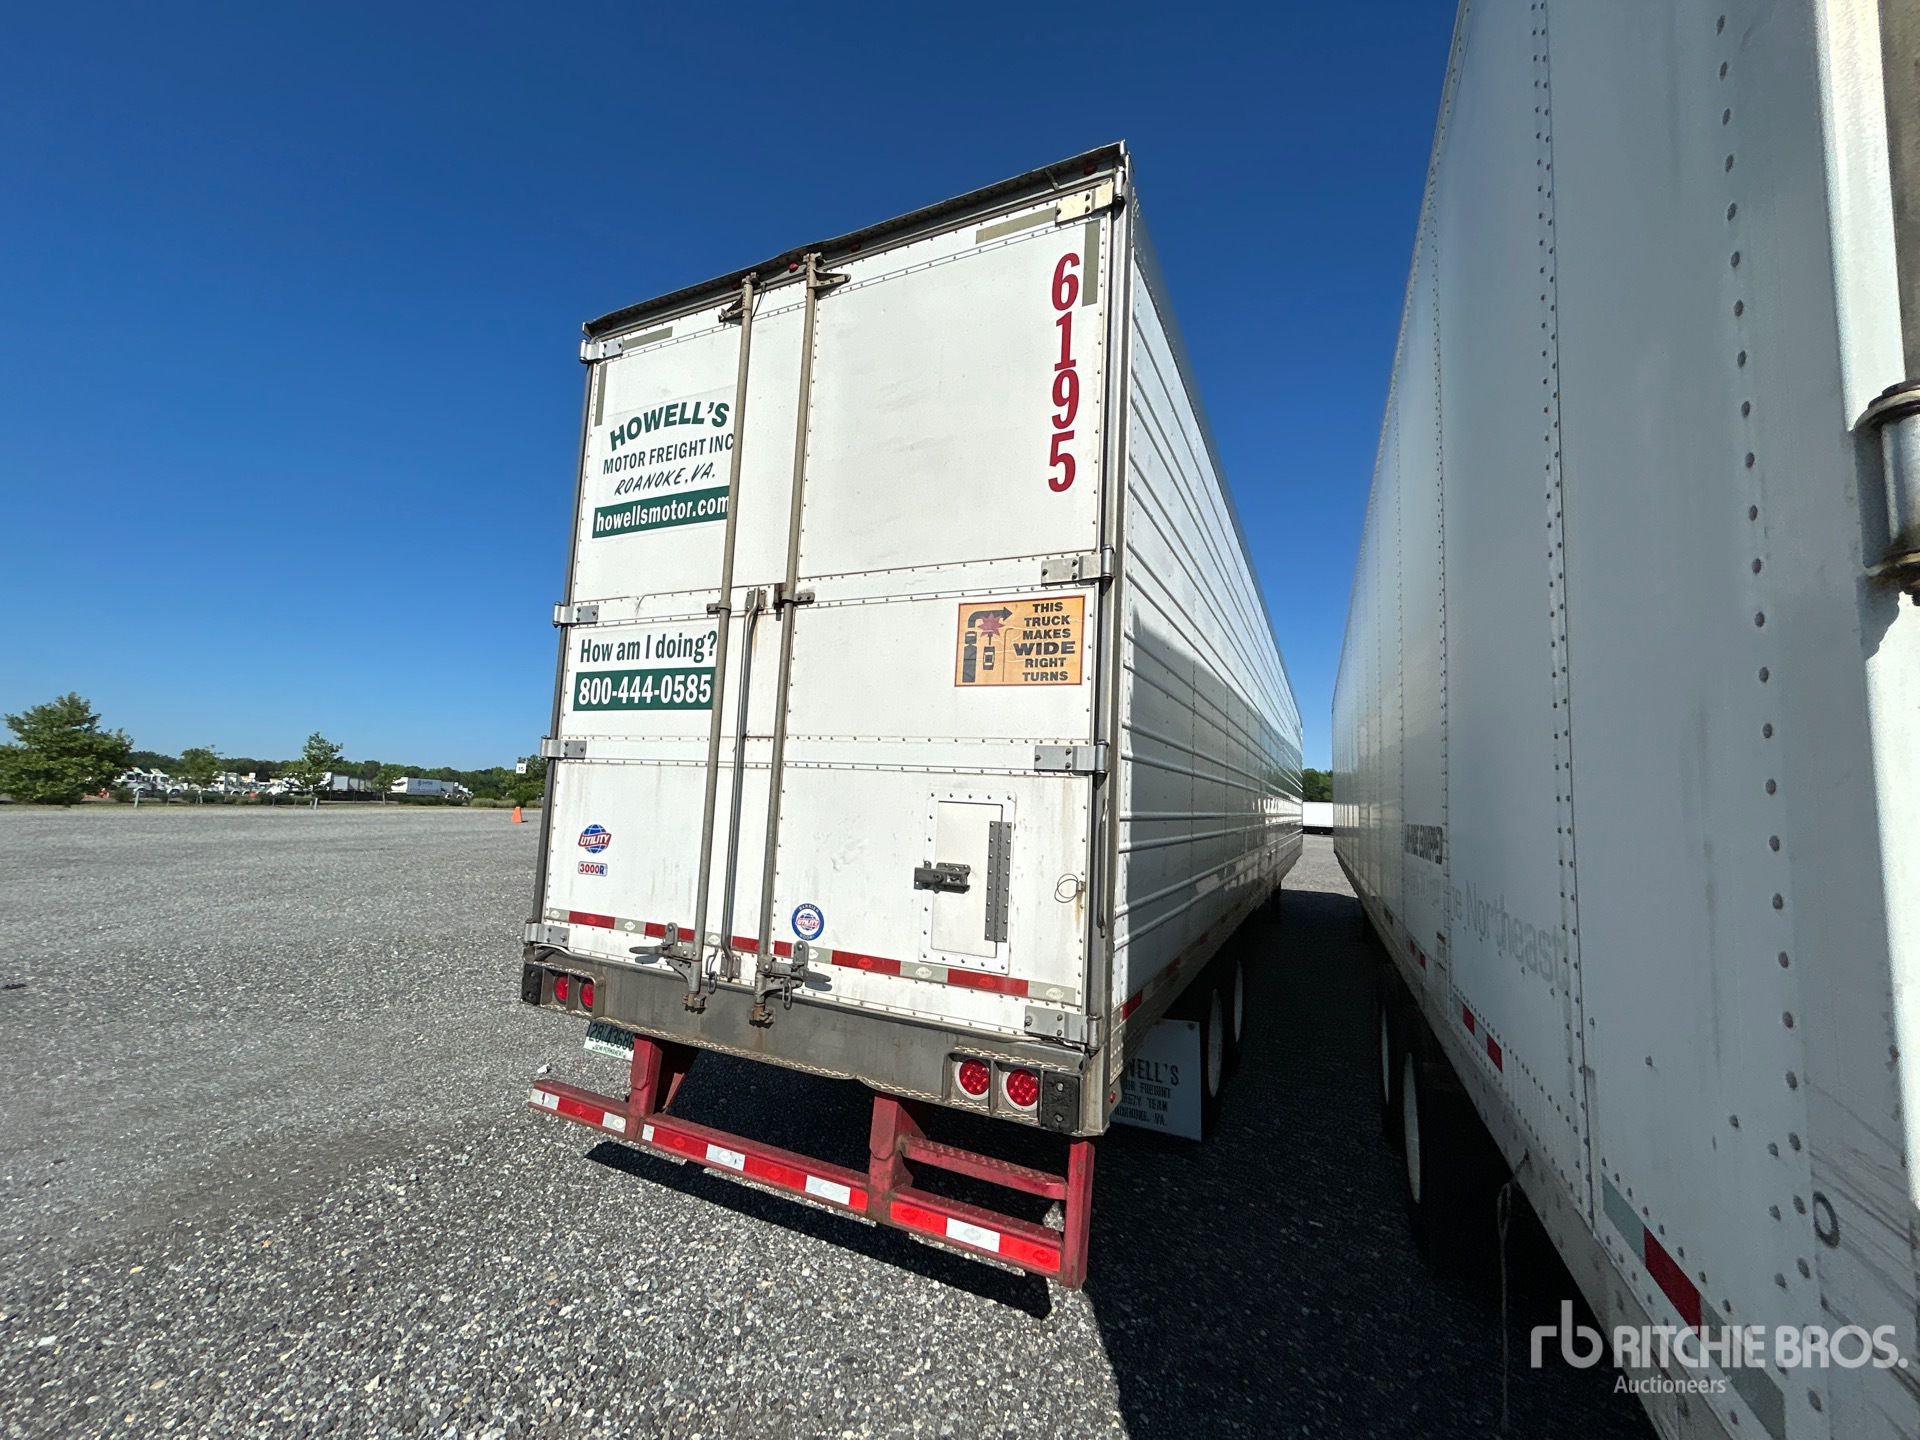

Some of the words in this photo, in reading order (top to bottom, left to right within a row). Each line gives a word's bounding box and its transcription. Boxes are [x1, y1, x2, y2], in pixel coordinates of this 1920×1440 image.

[1047, 252, 1080, 493] 6195
[609, 401, 730, 451] HOWELL'S
[603, 452, 646, 475] MOTOR
[649, 437, 706, 465] FREIGHT
[708, 432, 734, 454] INC
[690, 462, 716, 481] VA.
[596, 493, 729, 532] howellsmotor.com
[1032, 602, 1063, 613] THIS
[1024, 615, 1070, 627] TRUCK
[1022, 628, 1071, 640] MAKES
[580, 638, 613, 663] How
[616, 640, 640, 661] am
[645, 634, 651, 659] I
[655, 630, 717, 663] doing?
[1013, 641, 1076, 656] WIDE
[1024, 657, 1067, 668] RIGHT
[1022, 671, 1068, 682] TURNS
[578, 674, 712, 705] 800-444-0585
[580, 834, 610, 846] UTILITY
[579, 863, 605, 875] 3000R
